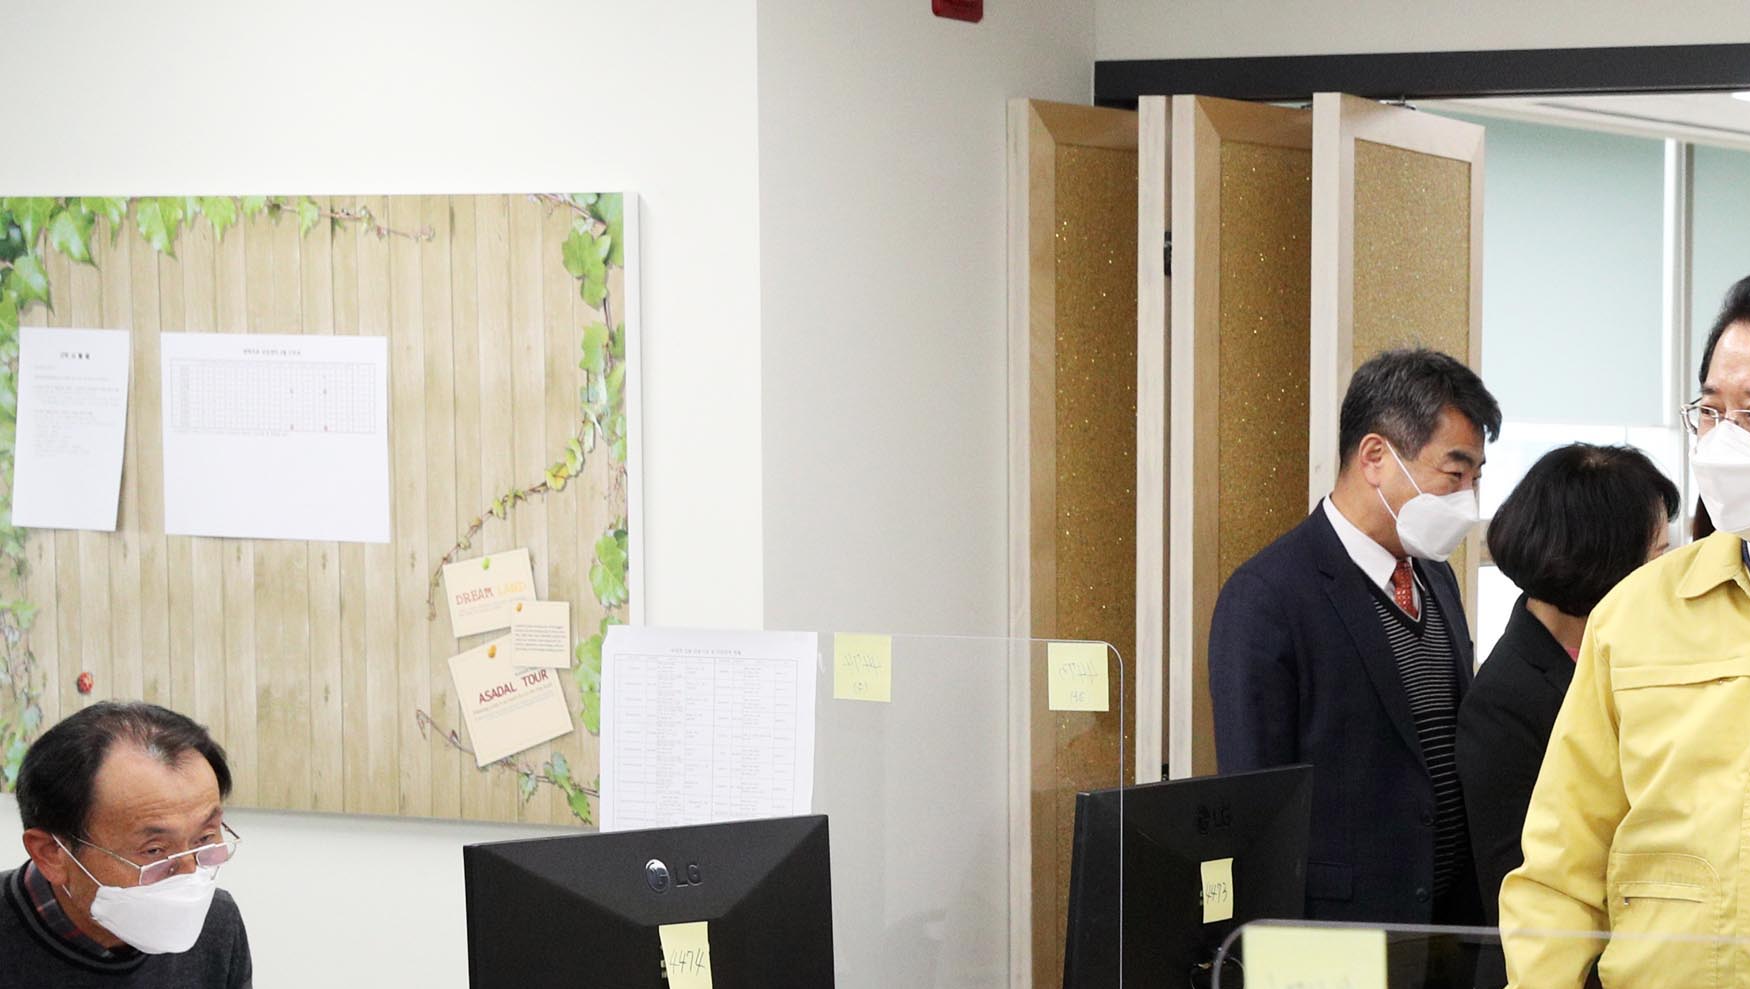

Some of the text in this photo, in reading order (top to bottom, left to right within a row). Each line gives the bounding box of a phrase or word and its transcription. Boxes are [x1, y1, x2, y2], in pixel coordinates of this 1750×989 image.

[455, 587, 495, 606] DREAM
[478, 668, 549, 704] ASADAL TOUR
[674, 864, 704, 887] LG
[669, 947, 705, 976] 4474
